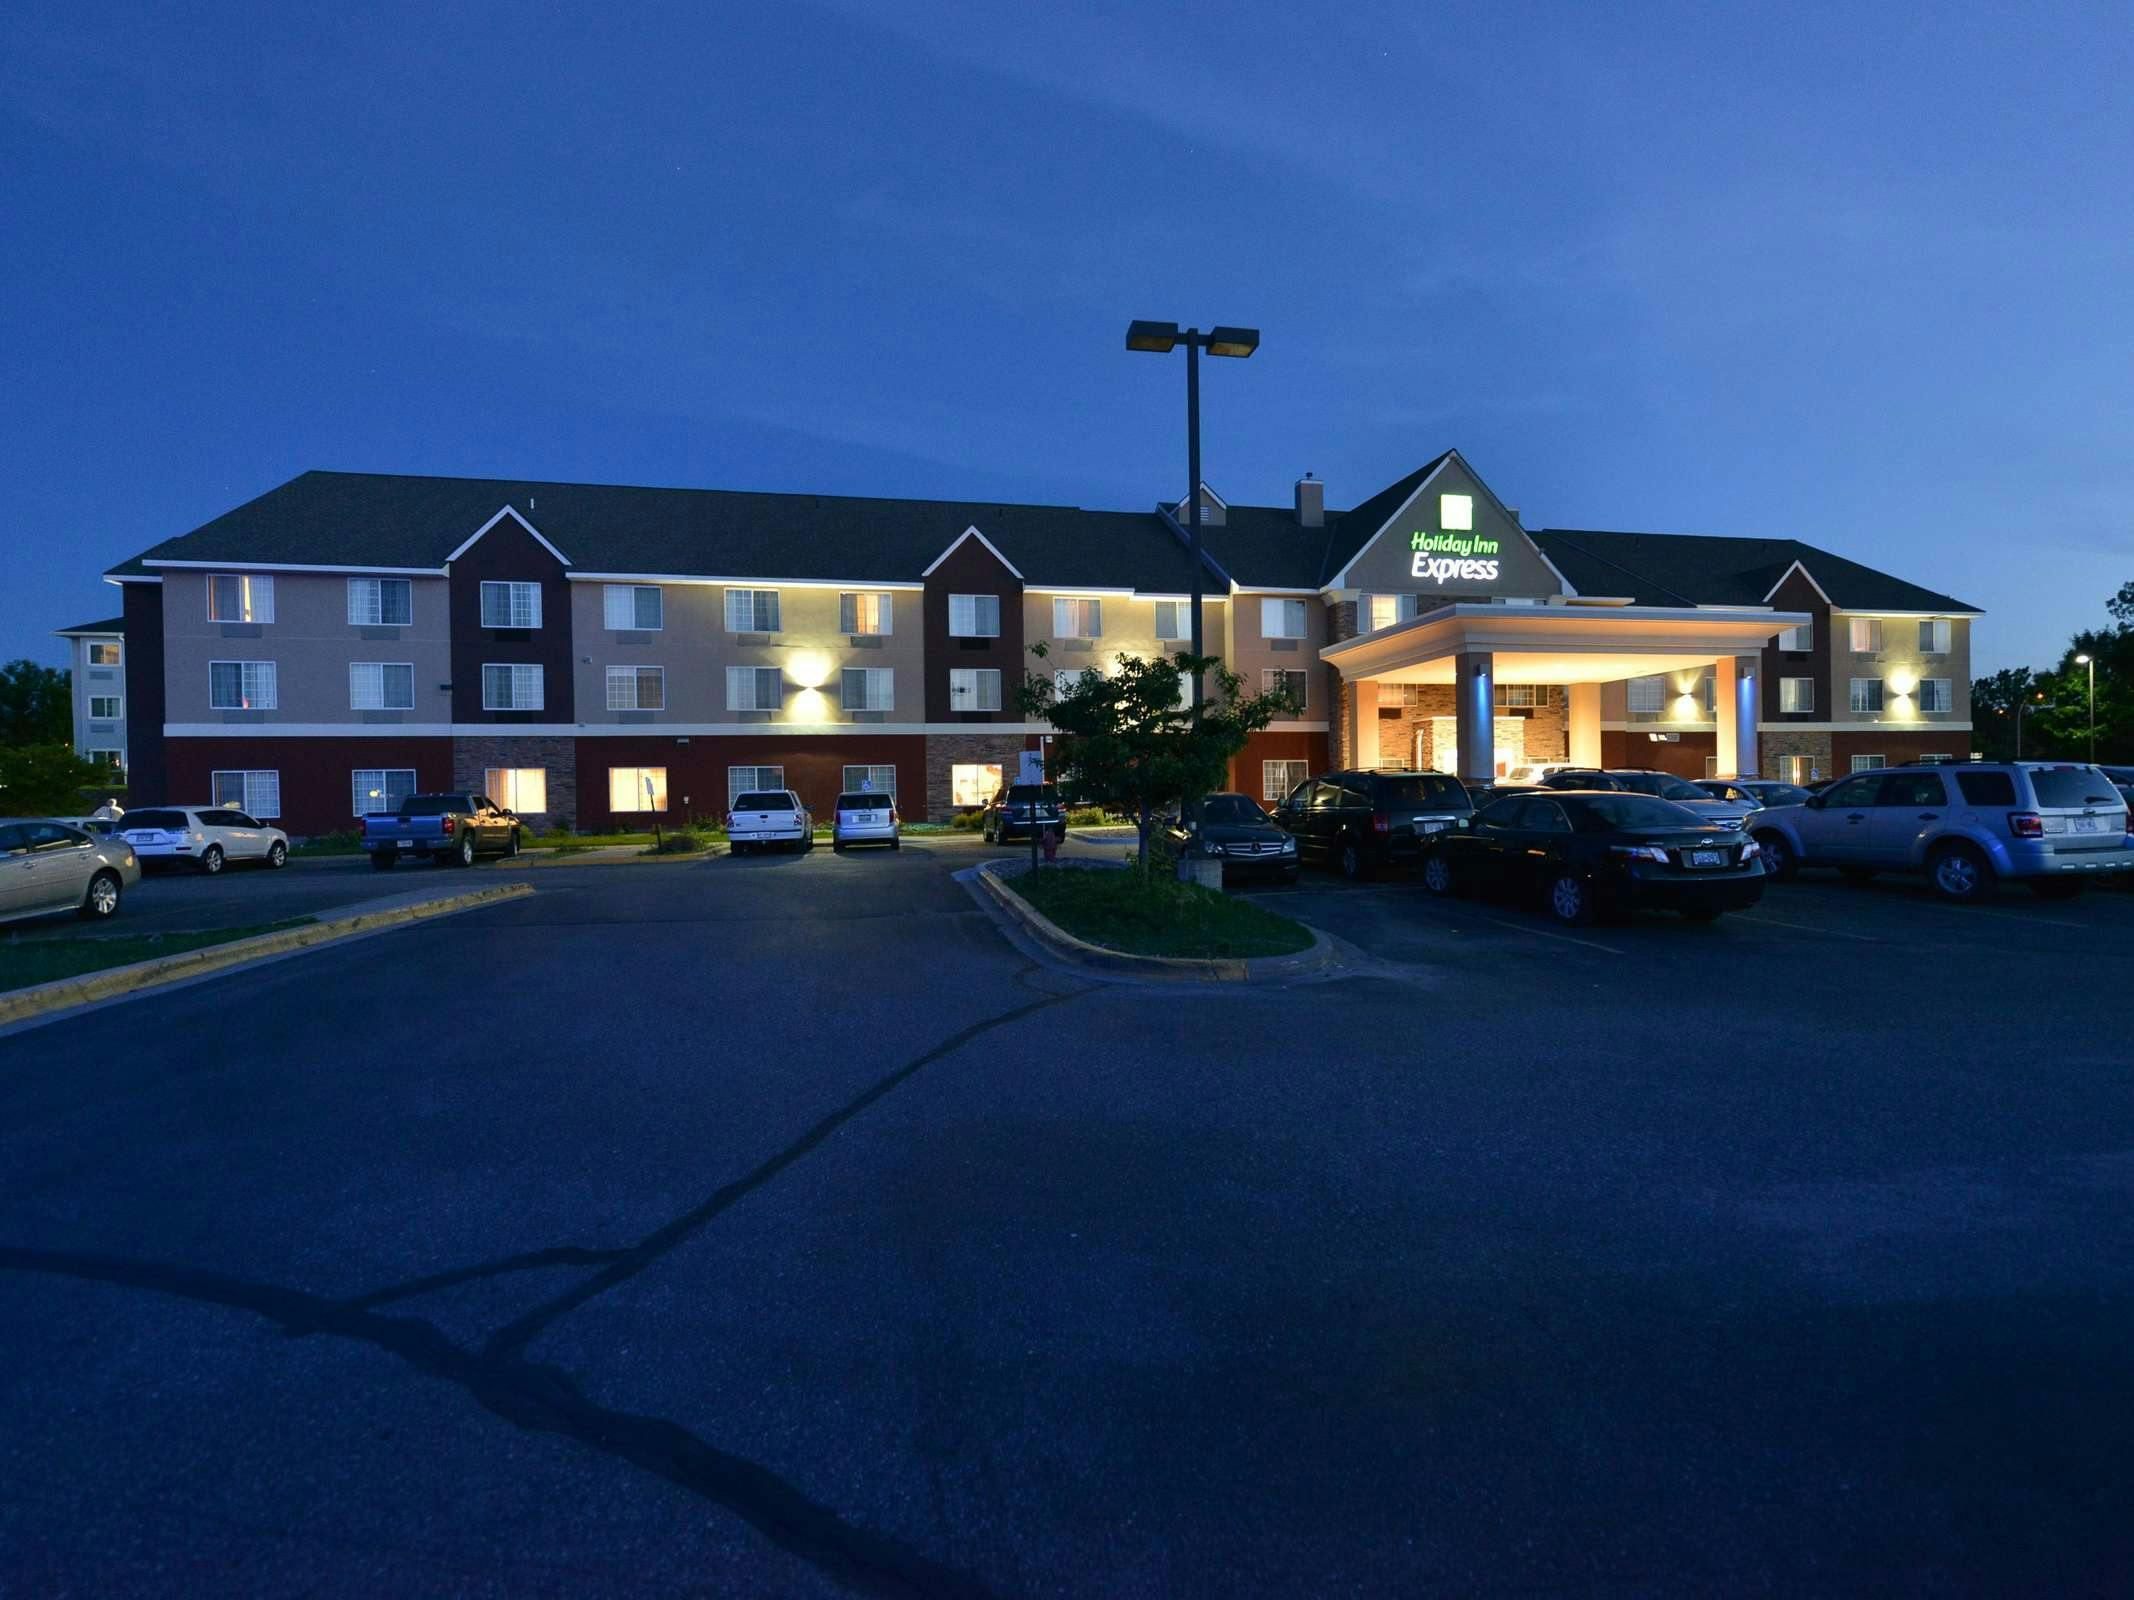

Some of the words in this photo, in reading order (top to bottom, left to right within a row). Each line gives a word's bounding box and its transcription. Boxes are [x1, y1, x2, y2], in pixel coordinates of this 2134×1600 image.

[1411, 532, 1471, 556] Holiday
[1473, 534, 1498, 553] Inn
[1411, 551, 1499, 584] Express
